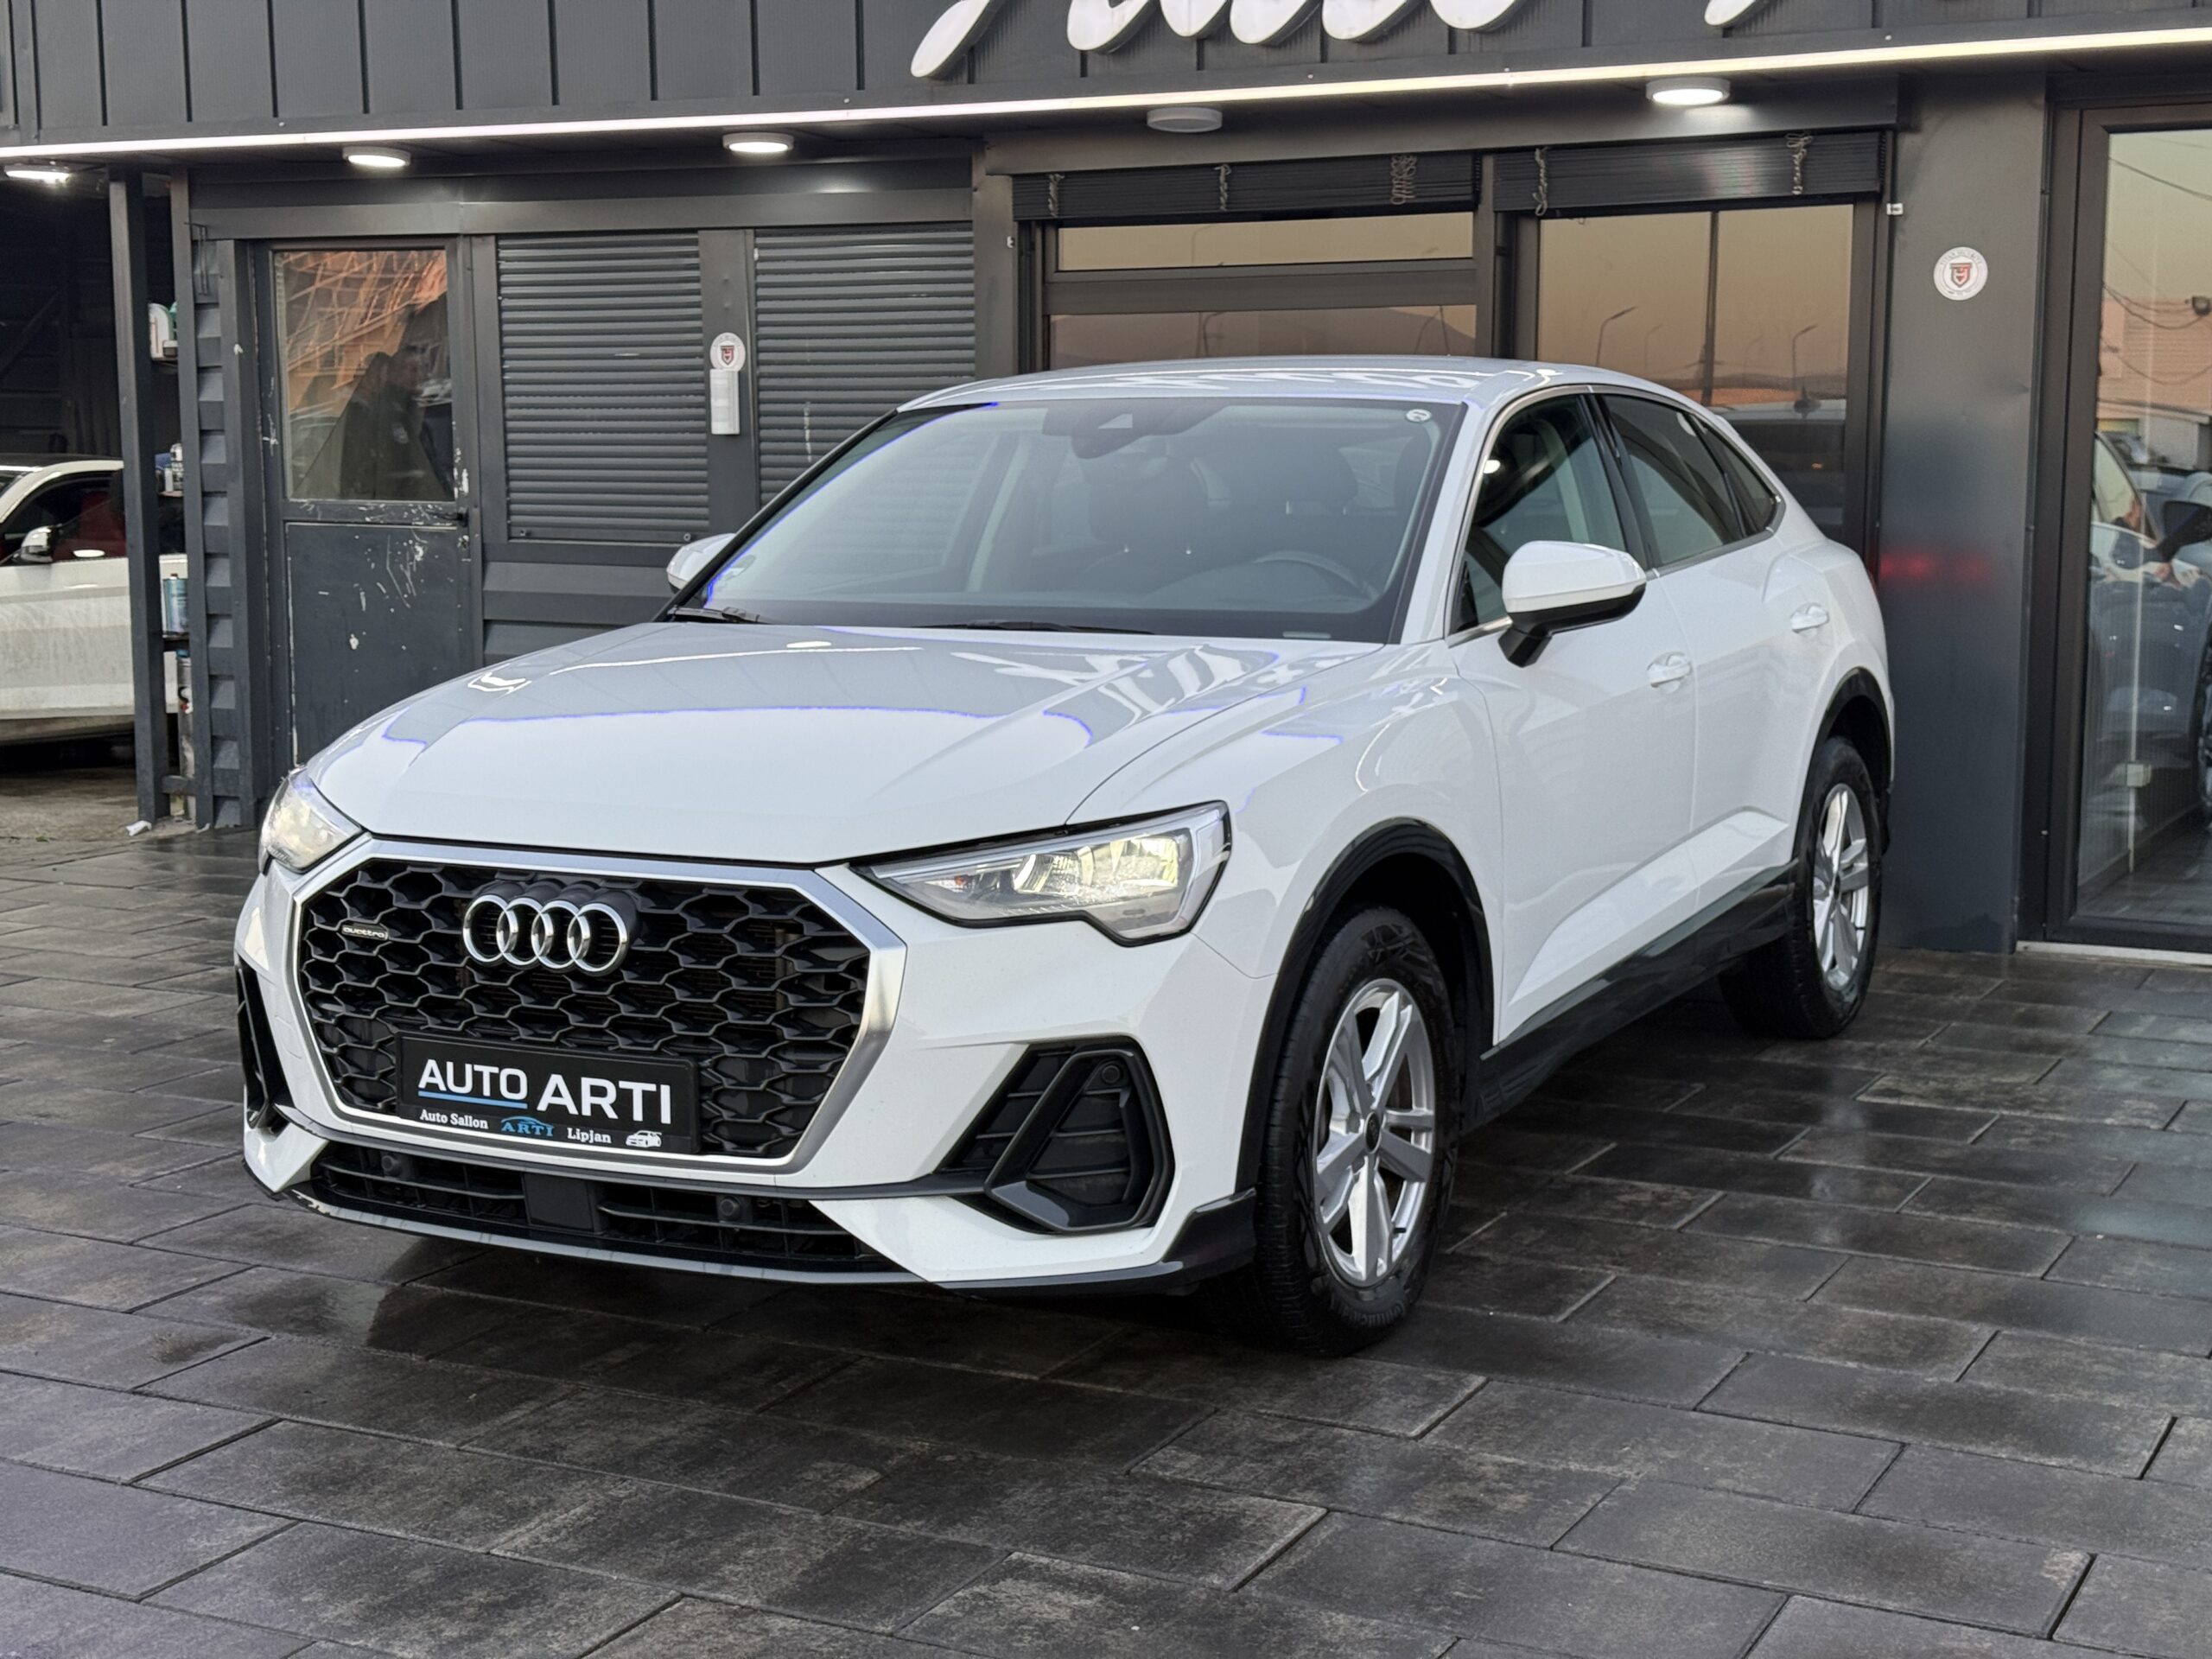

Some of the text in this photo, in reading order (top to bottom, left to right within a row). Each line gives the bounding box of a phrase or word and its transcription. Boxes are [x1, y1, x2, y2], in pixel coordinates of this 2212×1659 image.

[343, 926, 385, 938] quattro
[418, 1058, 671, 1124] AUTO ARTI
[420, 1109, 612, 1144] Auto Sallon ARTI Lipjan
